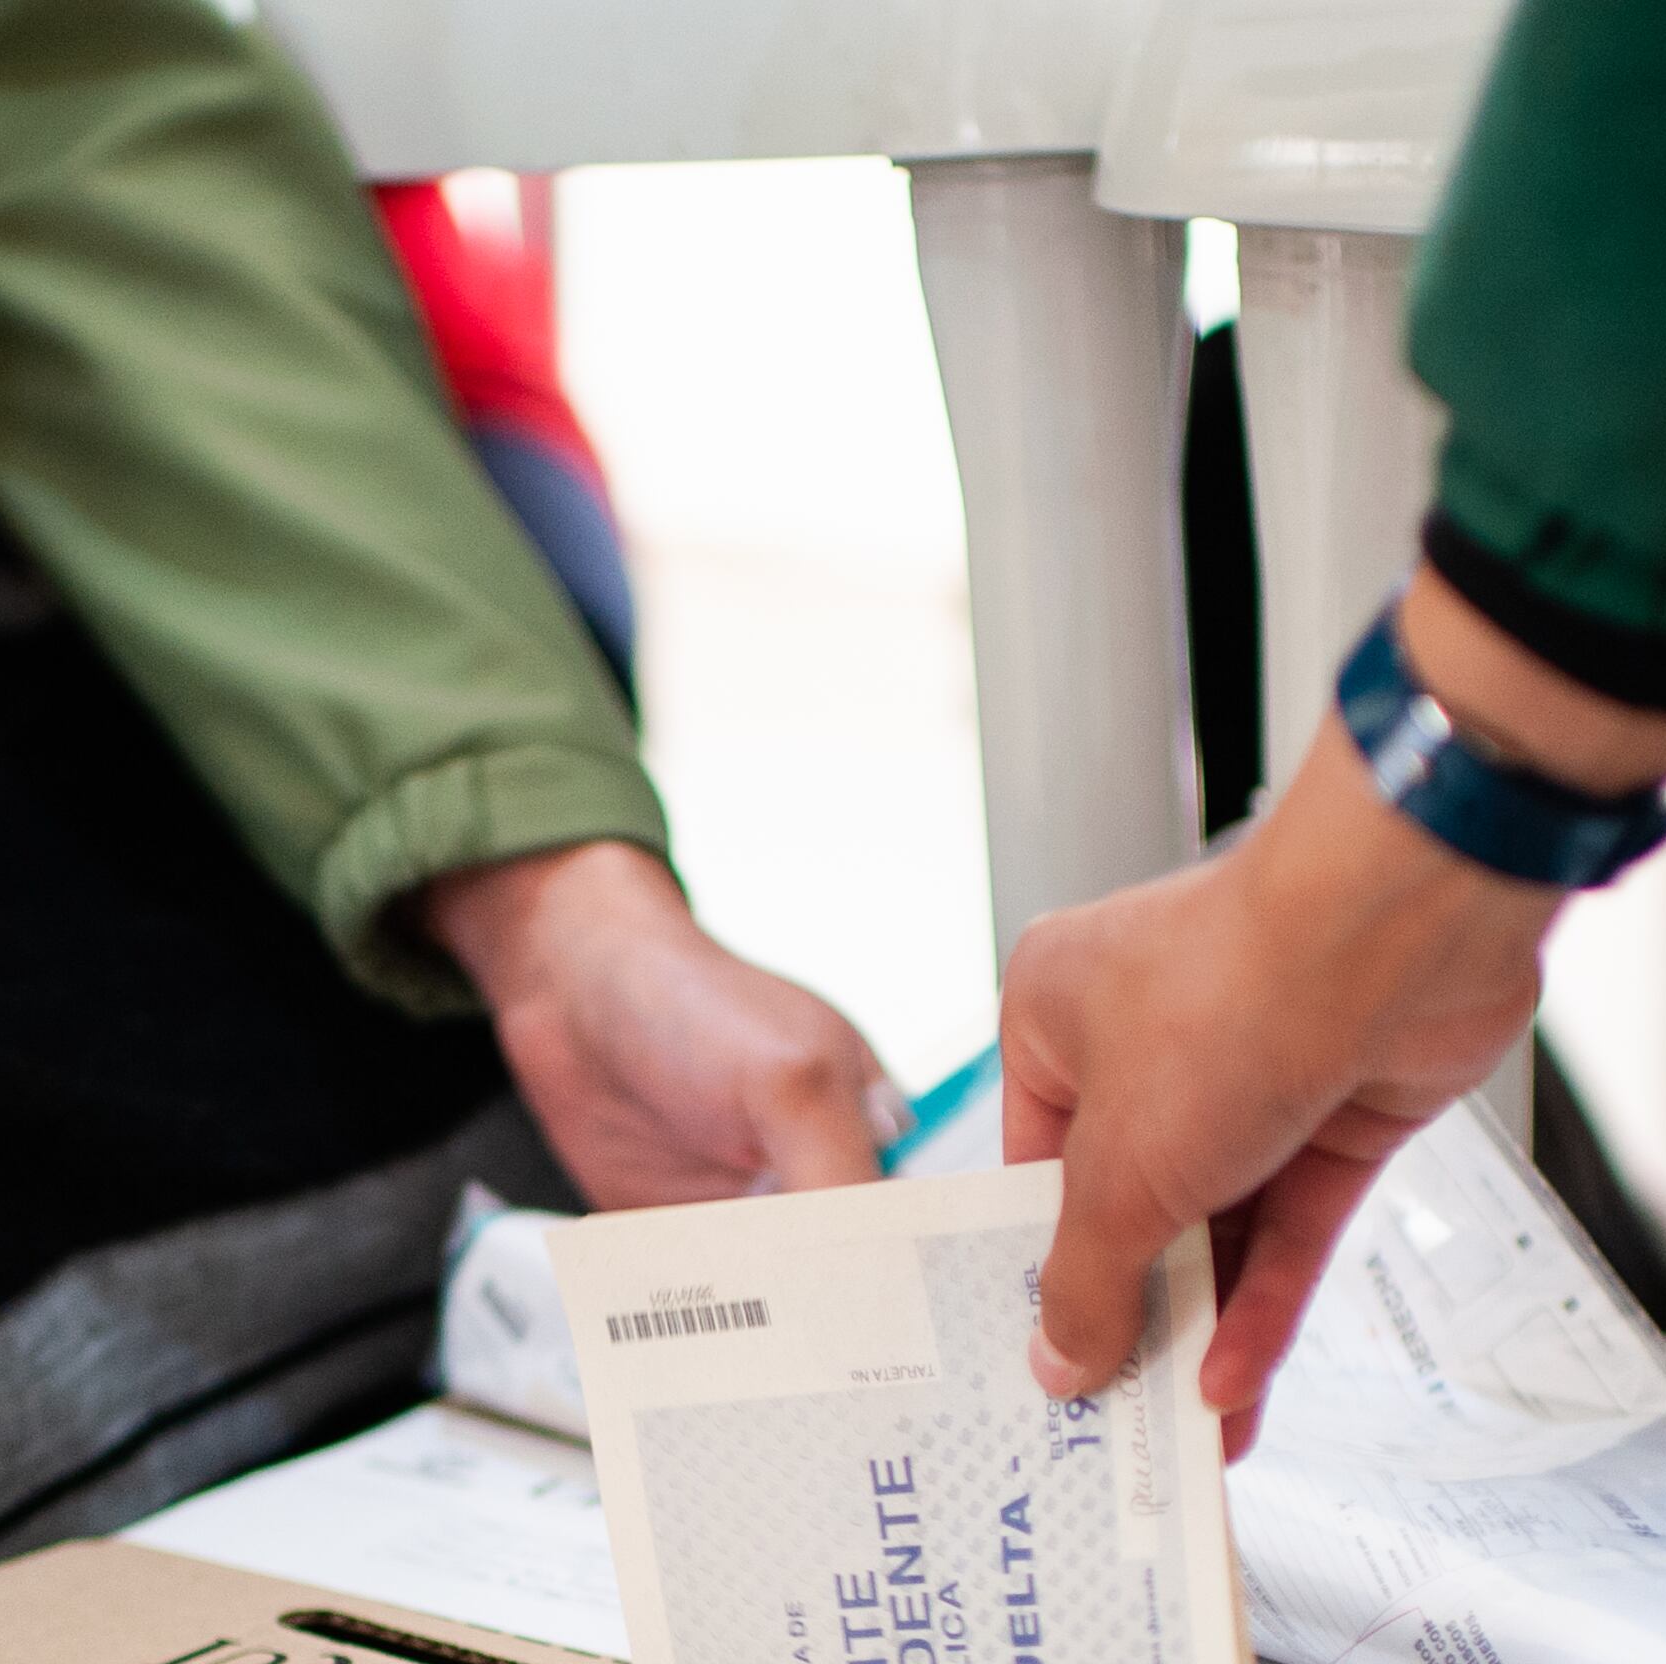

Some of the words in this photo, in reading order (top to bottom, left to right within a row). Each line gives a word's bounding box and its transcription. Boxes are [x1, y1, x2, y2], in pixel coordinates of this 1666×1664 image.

[873, 1364, 935, 1382] TARJETA
[1046, 1393, 1064, 1460] ELEC
[785, 1600, 808, 1636] DE
[1422, 1619, 1447, 1652] CON
